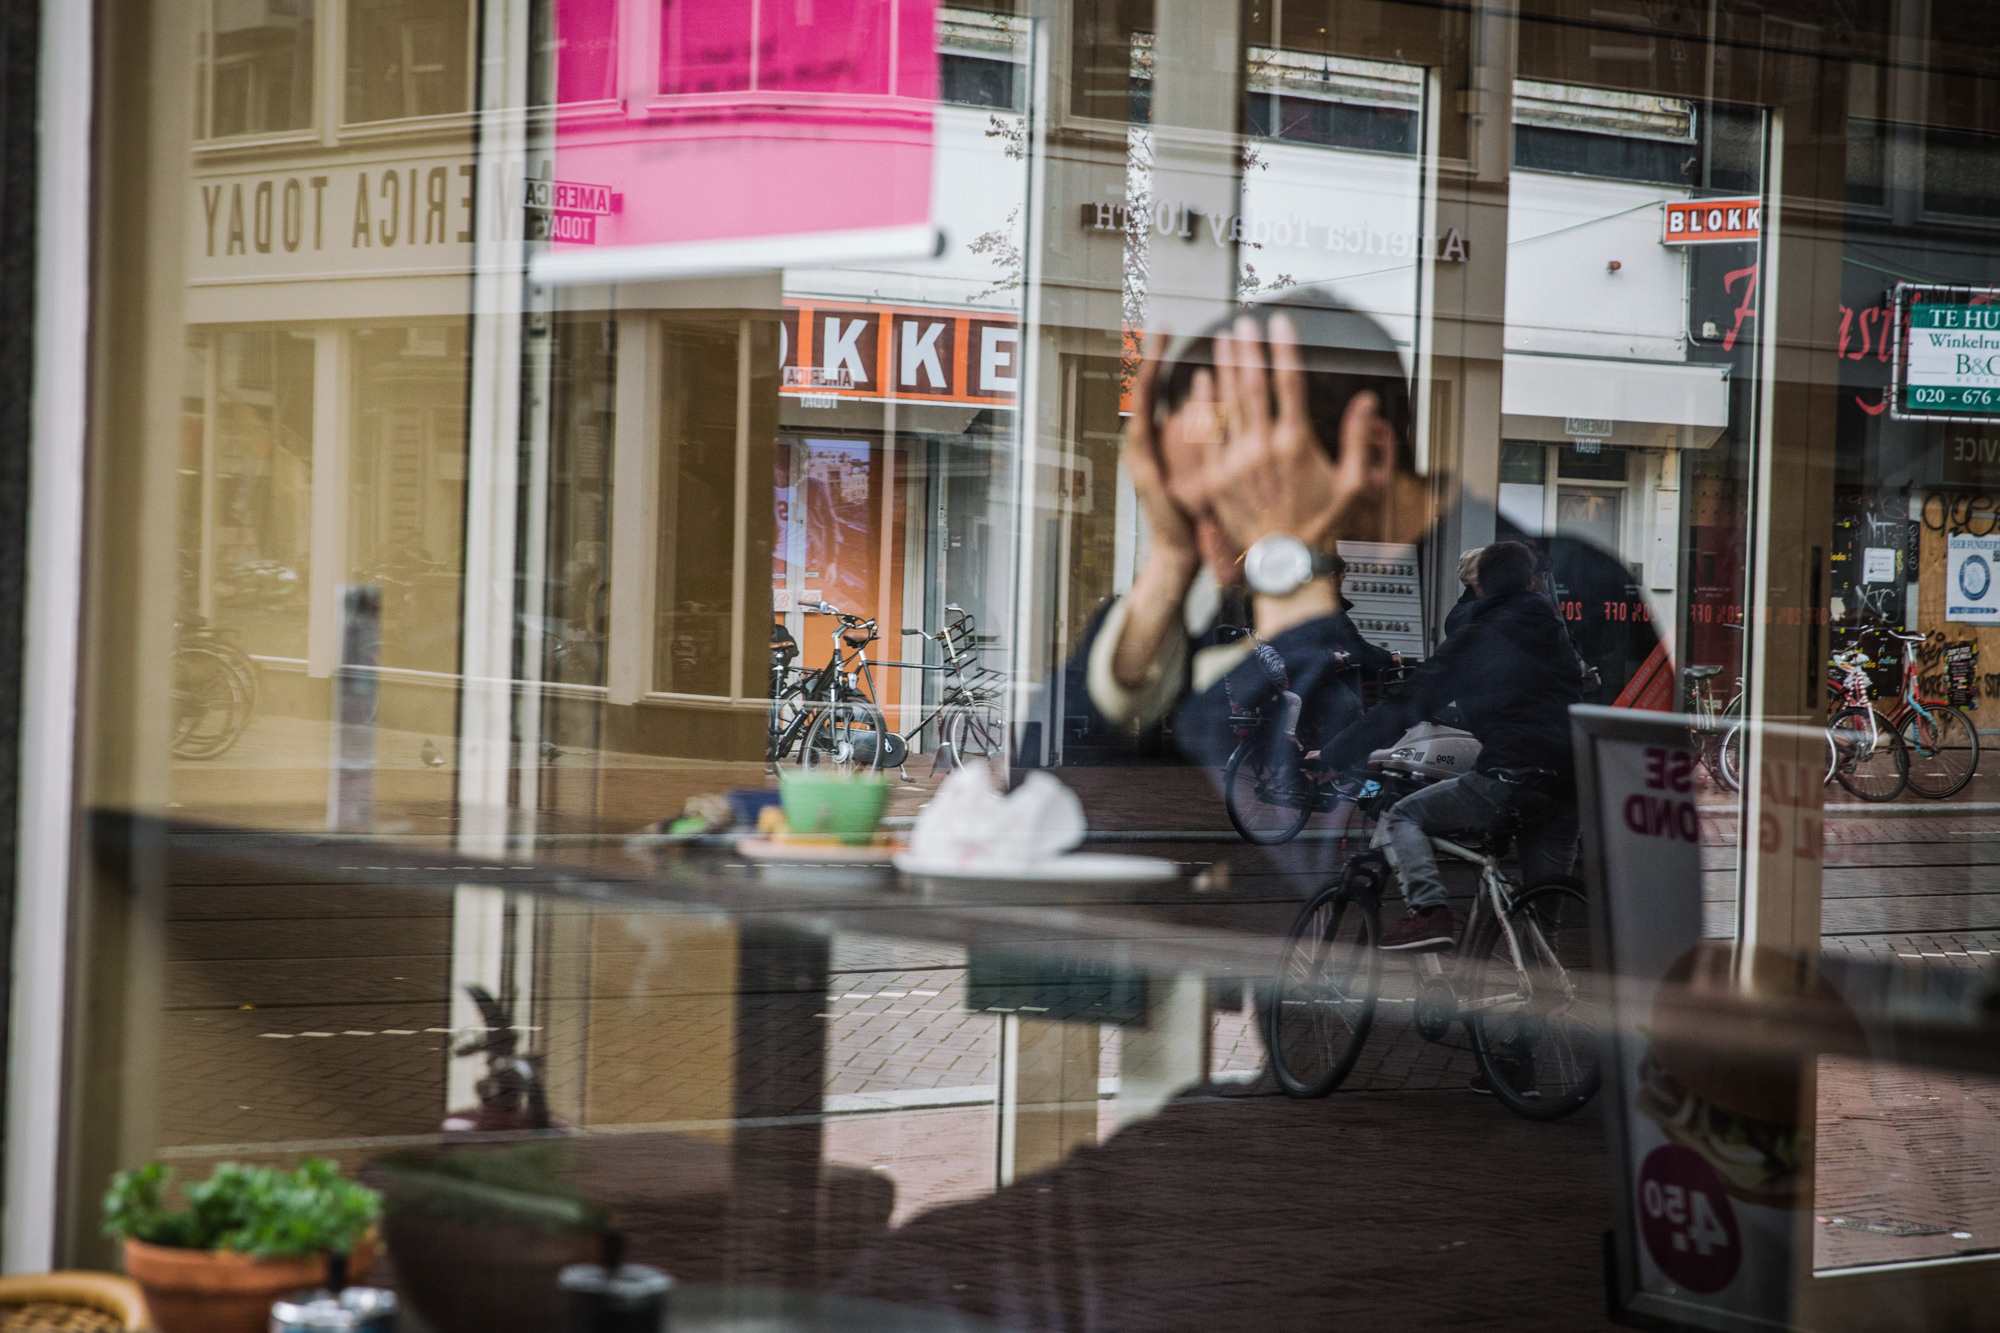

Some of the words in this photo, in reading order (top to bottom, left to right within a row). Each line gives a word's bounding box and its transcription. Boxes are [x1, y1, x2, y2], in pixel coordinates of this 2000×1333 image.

[1929, 309, 1959, 327] TE
[1916, 389, 1945, 403] 020
[1962, 390, 1991, 406] 676
